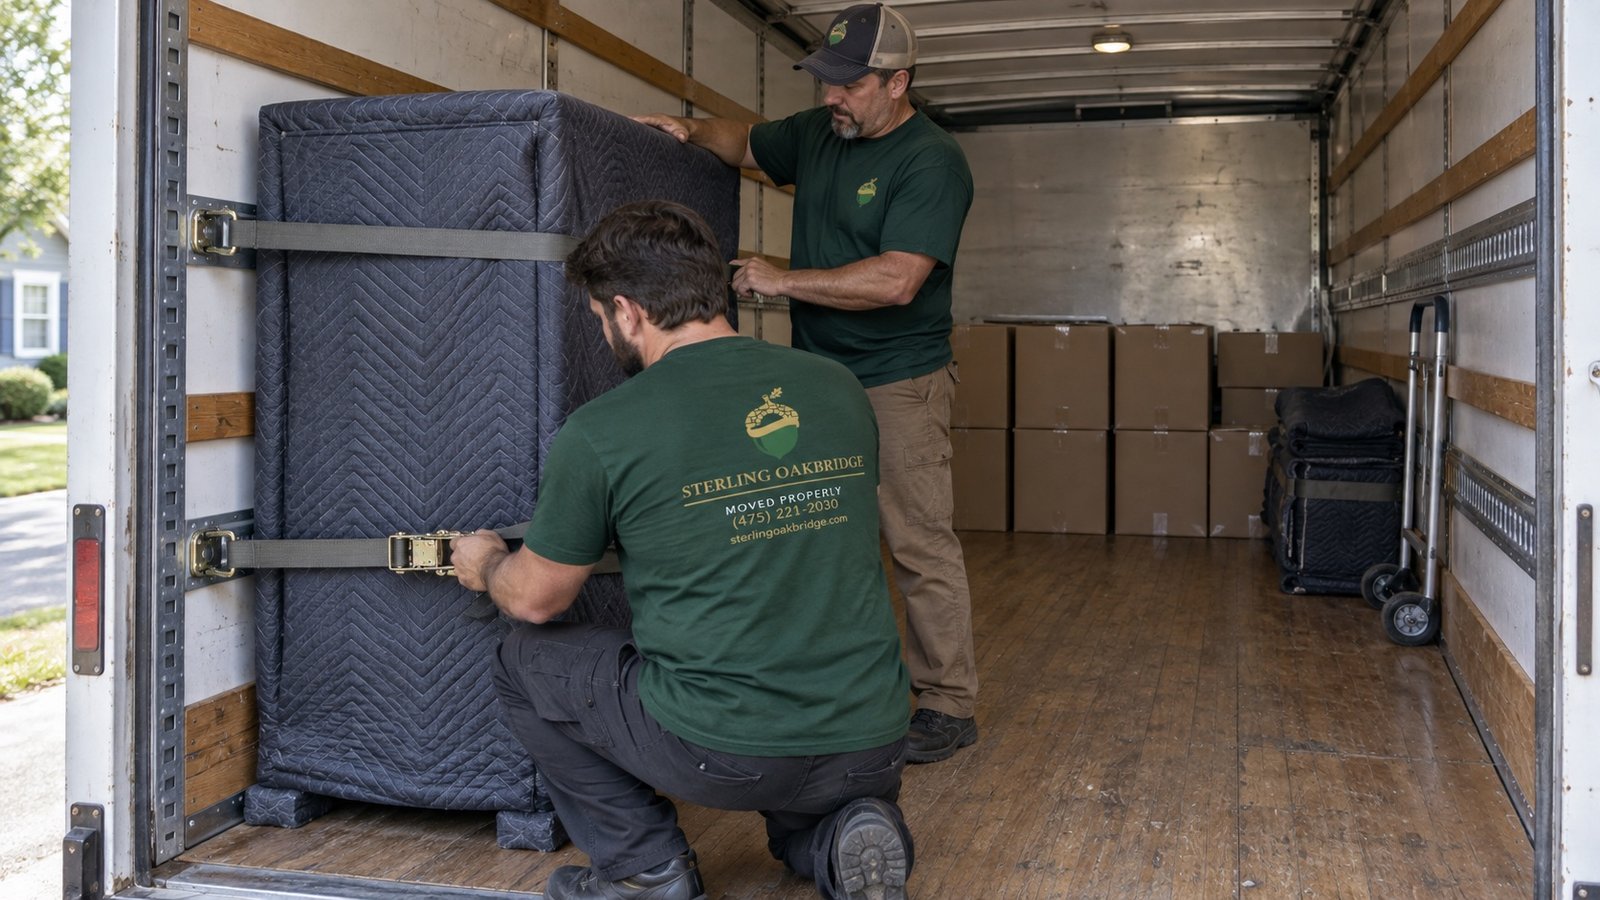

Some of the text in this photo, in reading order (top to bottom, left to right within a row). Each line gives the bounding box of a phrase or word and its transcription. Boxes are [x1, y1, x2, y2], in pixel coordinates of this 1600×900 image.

[682, 455, 864, 498] STERLING OAKBRIDGE
[725, 486, 842, 515] MOVED PROPERLY
[733, 499, 839, 530] (475) 221-2030
[730, 514, 848, 545] sterlingoakbridge.com
